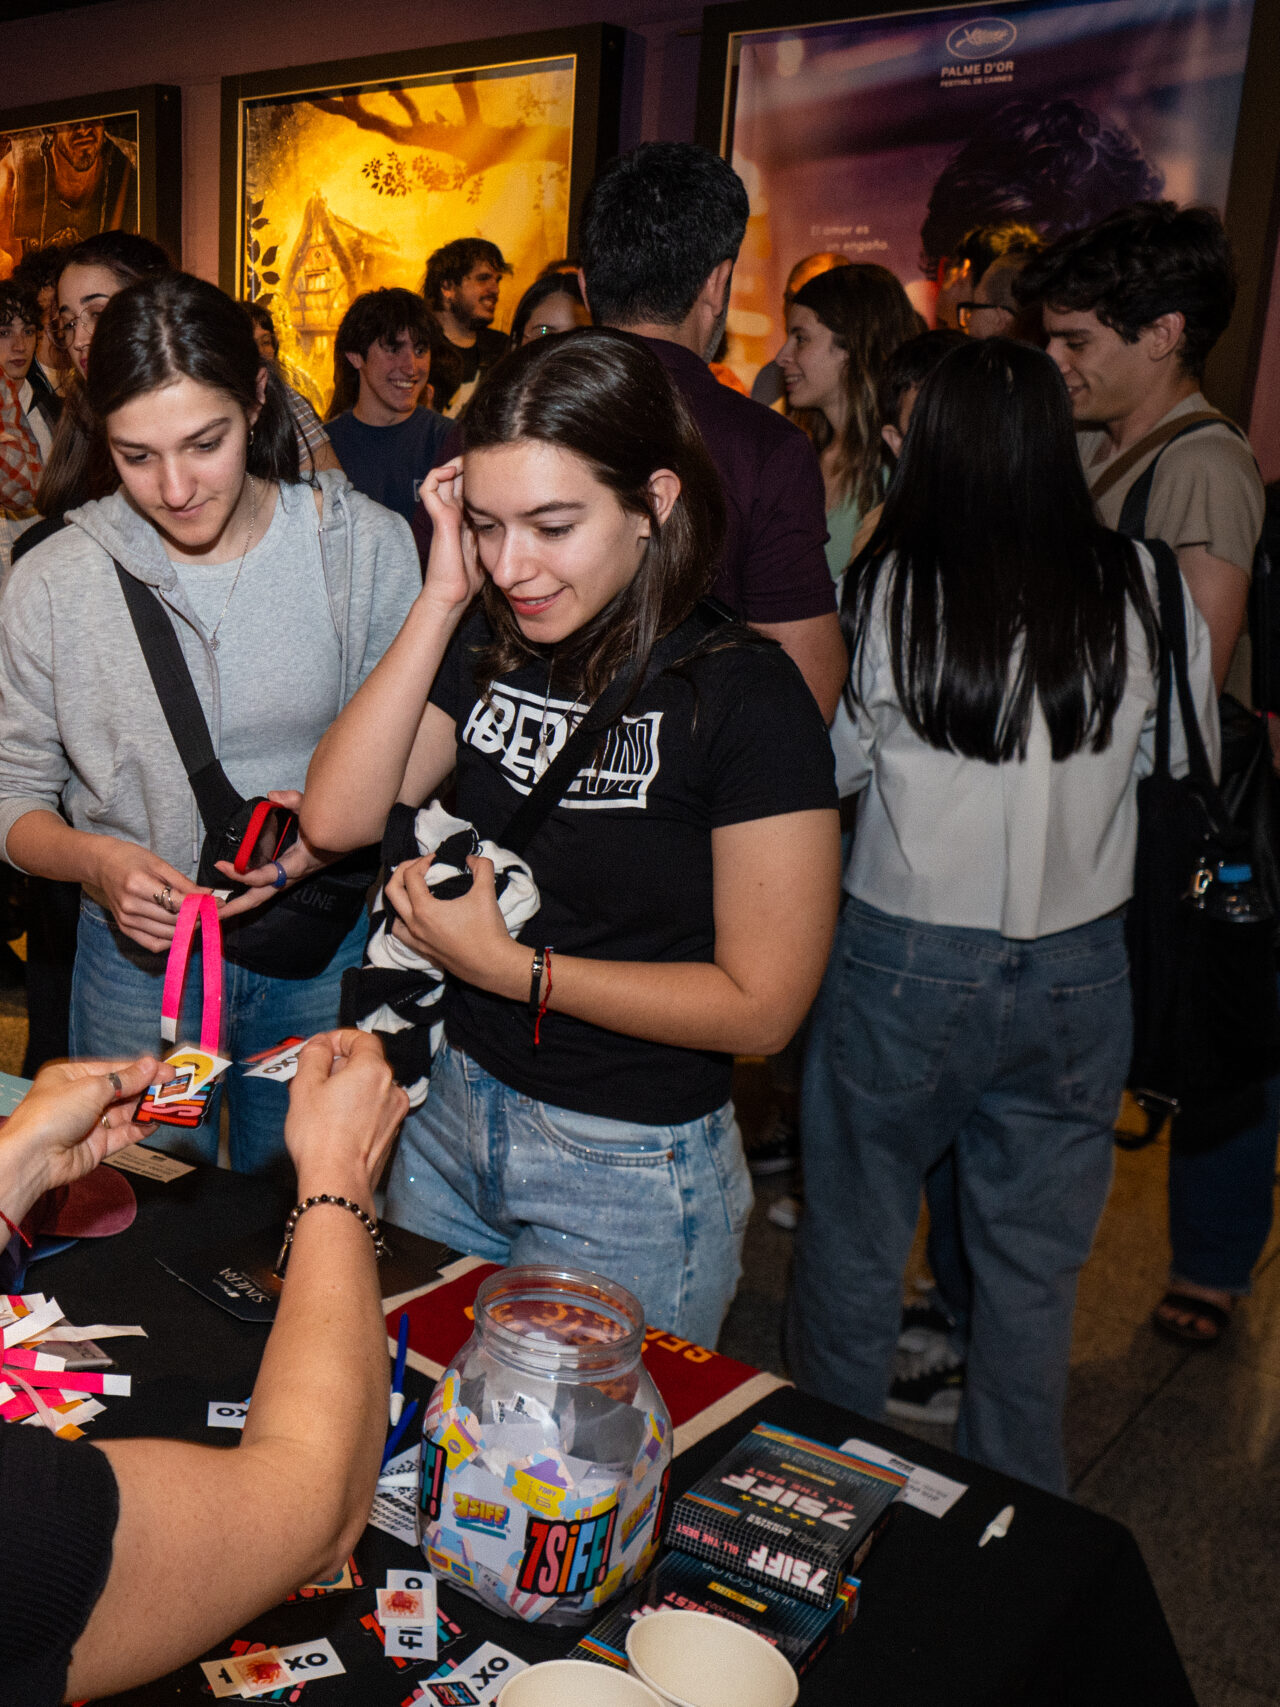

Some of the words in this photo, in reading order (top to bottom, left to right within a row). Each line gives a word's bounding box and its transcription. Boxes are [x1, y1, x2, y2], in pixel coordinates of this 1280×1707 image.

[941, 64, 982, 78] PALME
[984, 60, 1015, 74] D'OR
[745, 1466, 787, 1486] BEST
[789, 1482, 819, 1499] THE
[721, 1473, 857, 1531] 7SIFF
[676, 1523, 700, 1541] BEST
[701, 1531, 721, 1548] THE
[722, 1540, 740, 1555] ALL
[747, 1545, 829, 1596] 7SIFF
